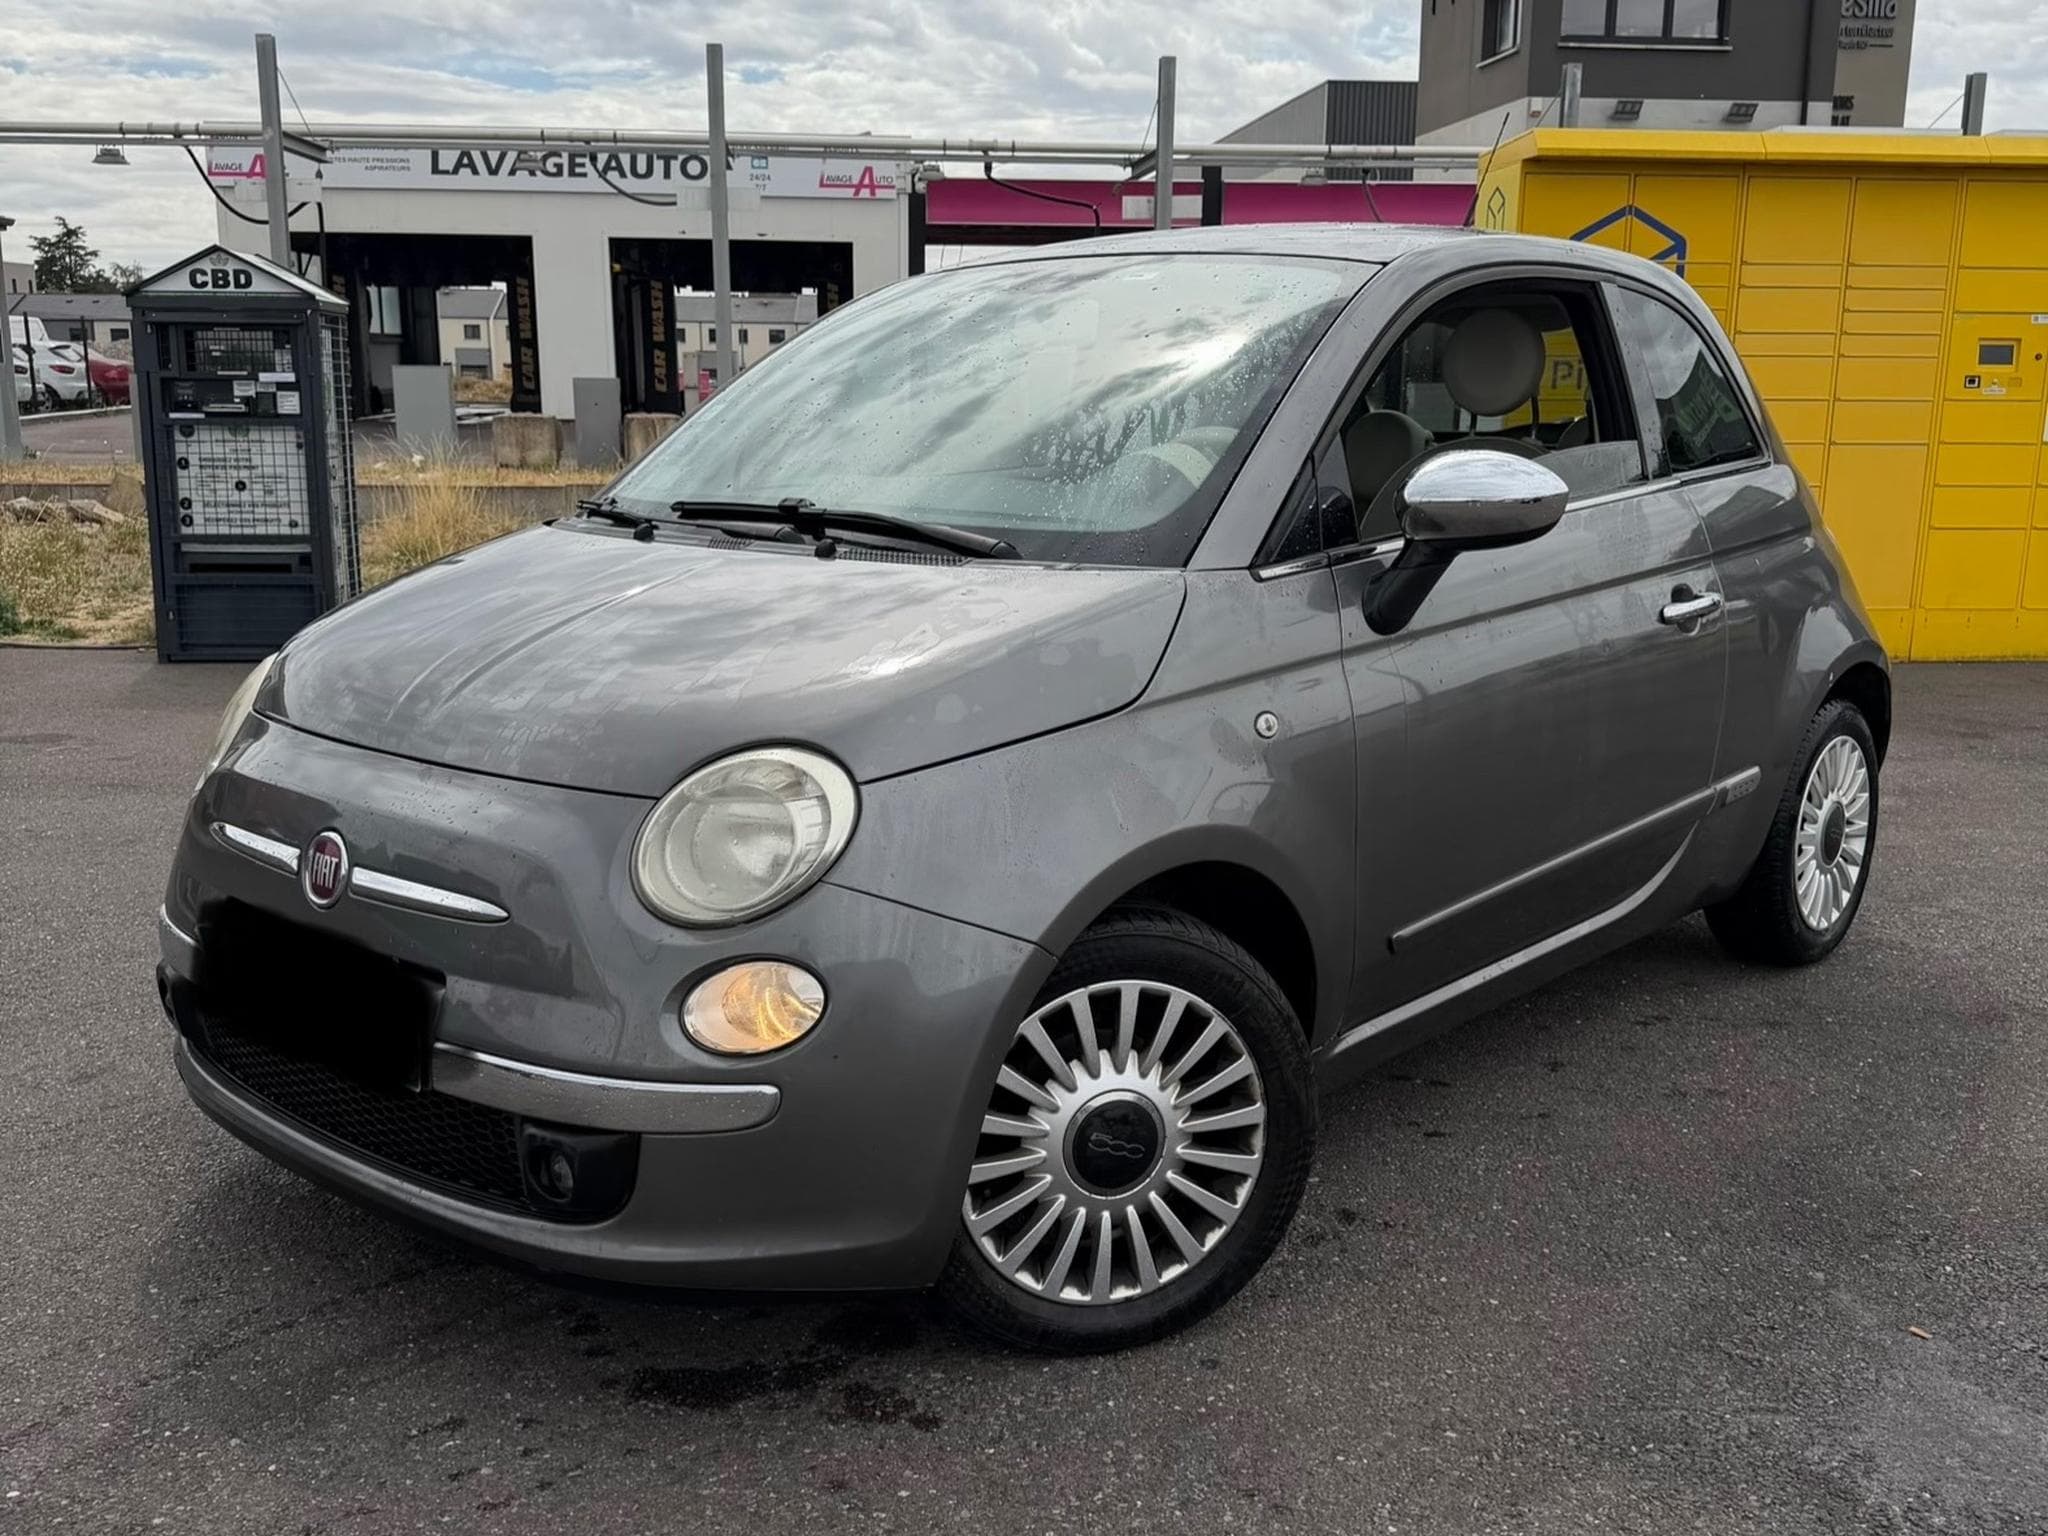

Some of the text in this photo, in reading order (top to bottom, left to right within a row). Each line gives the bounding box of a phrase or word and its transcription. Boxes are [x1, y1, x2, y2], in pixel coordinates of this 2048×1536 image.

[430, 150, 709, 181] LAVAGE AUTO
[750, 173, 771, 182] 24/24
[819, 170, 854, 188] LAVAGE
[189, 268, 253, 289] CBD
[516, 276, 535, 390] CAR WASH
[650, 280, 667, 392] CAR WASH
[312, 851, 339, 889] FIAT
[1088, 1132, 1145, 1158] 500
